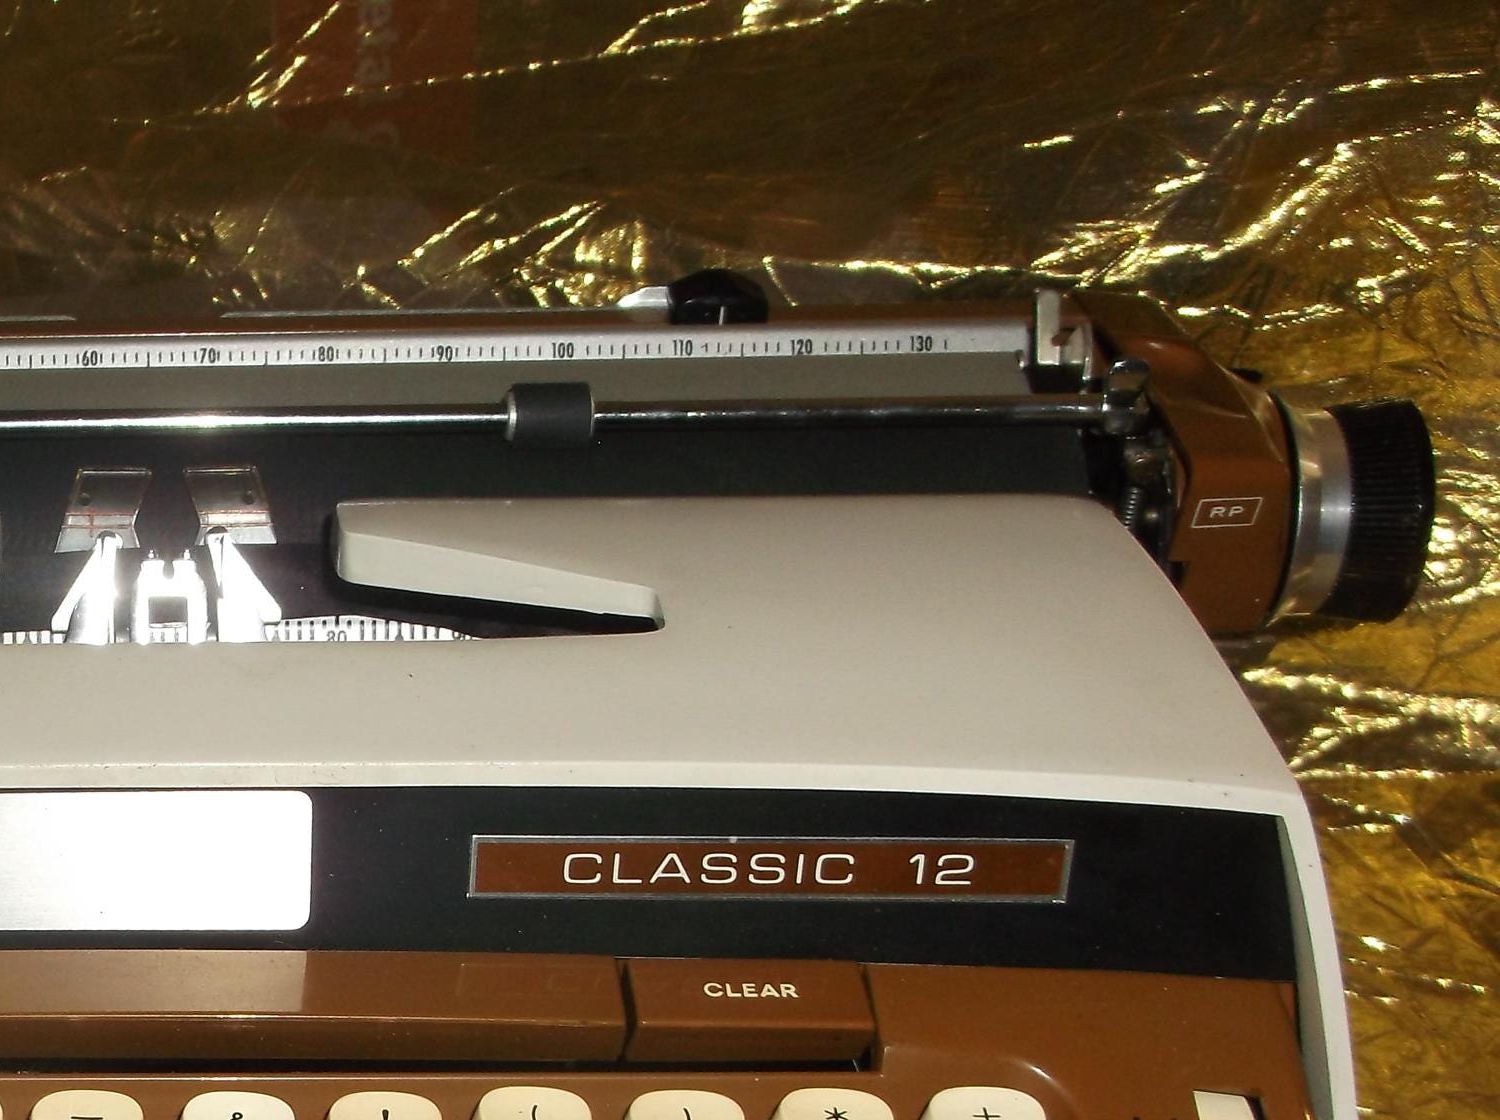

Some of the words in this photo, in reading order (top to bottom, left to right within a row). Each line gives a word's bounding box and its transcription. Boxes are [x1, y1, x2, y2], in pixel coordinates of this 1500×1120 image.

[81, 350, 98, 367] 60
[199, 347, 216, 364] 70
[317, 345, 334, 362] 80
[435, 345, 453, 362] 90
[551, 342, 574, 358] 100
[672, 339, 694, 357] 110
[790, 338, 813, 355] 120
[910, 335, 933, 353] 130
[1209, 505, 1245, 518] RP
[563, 852, 855, 885] CLASSIC
[909, 853, 975, 885] 12
[703, 982, 799, 998] CLEAR
